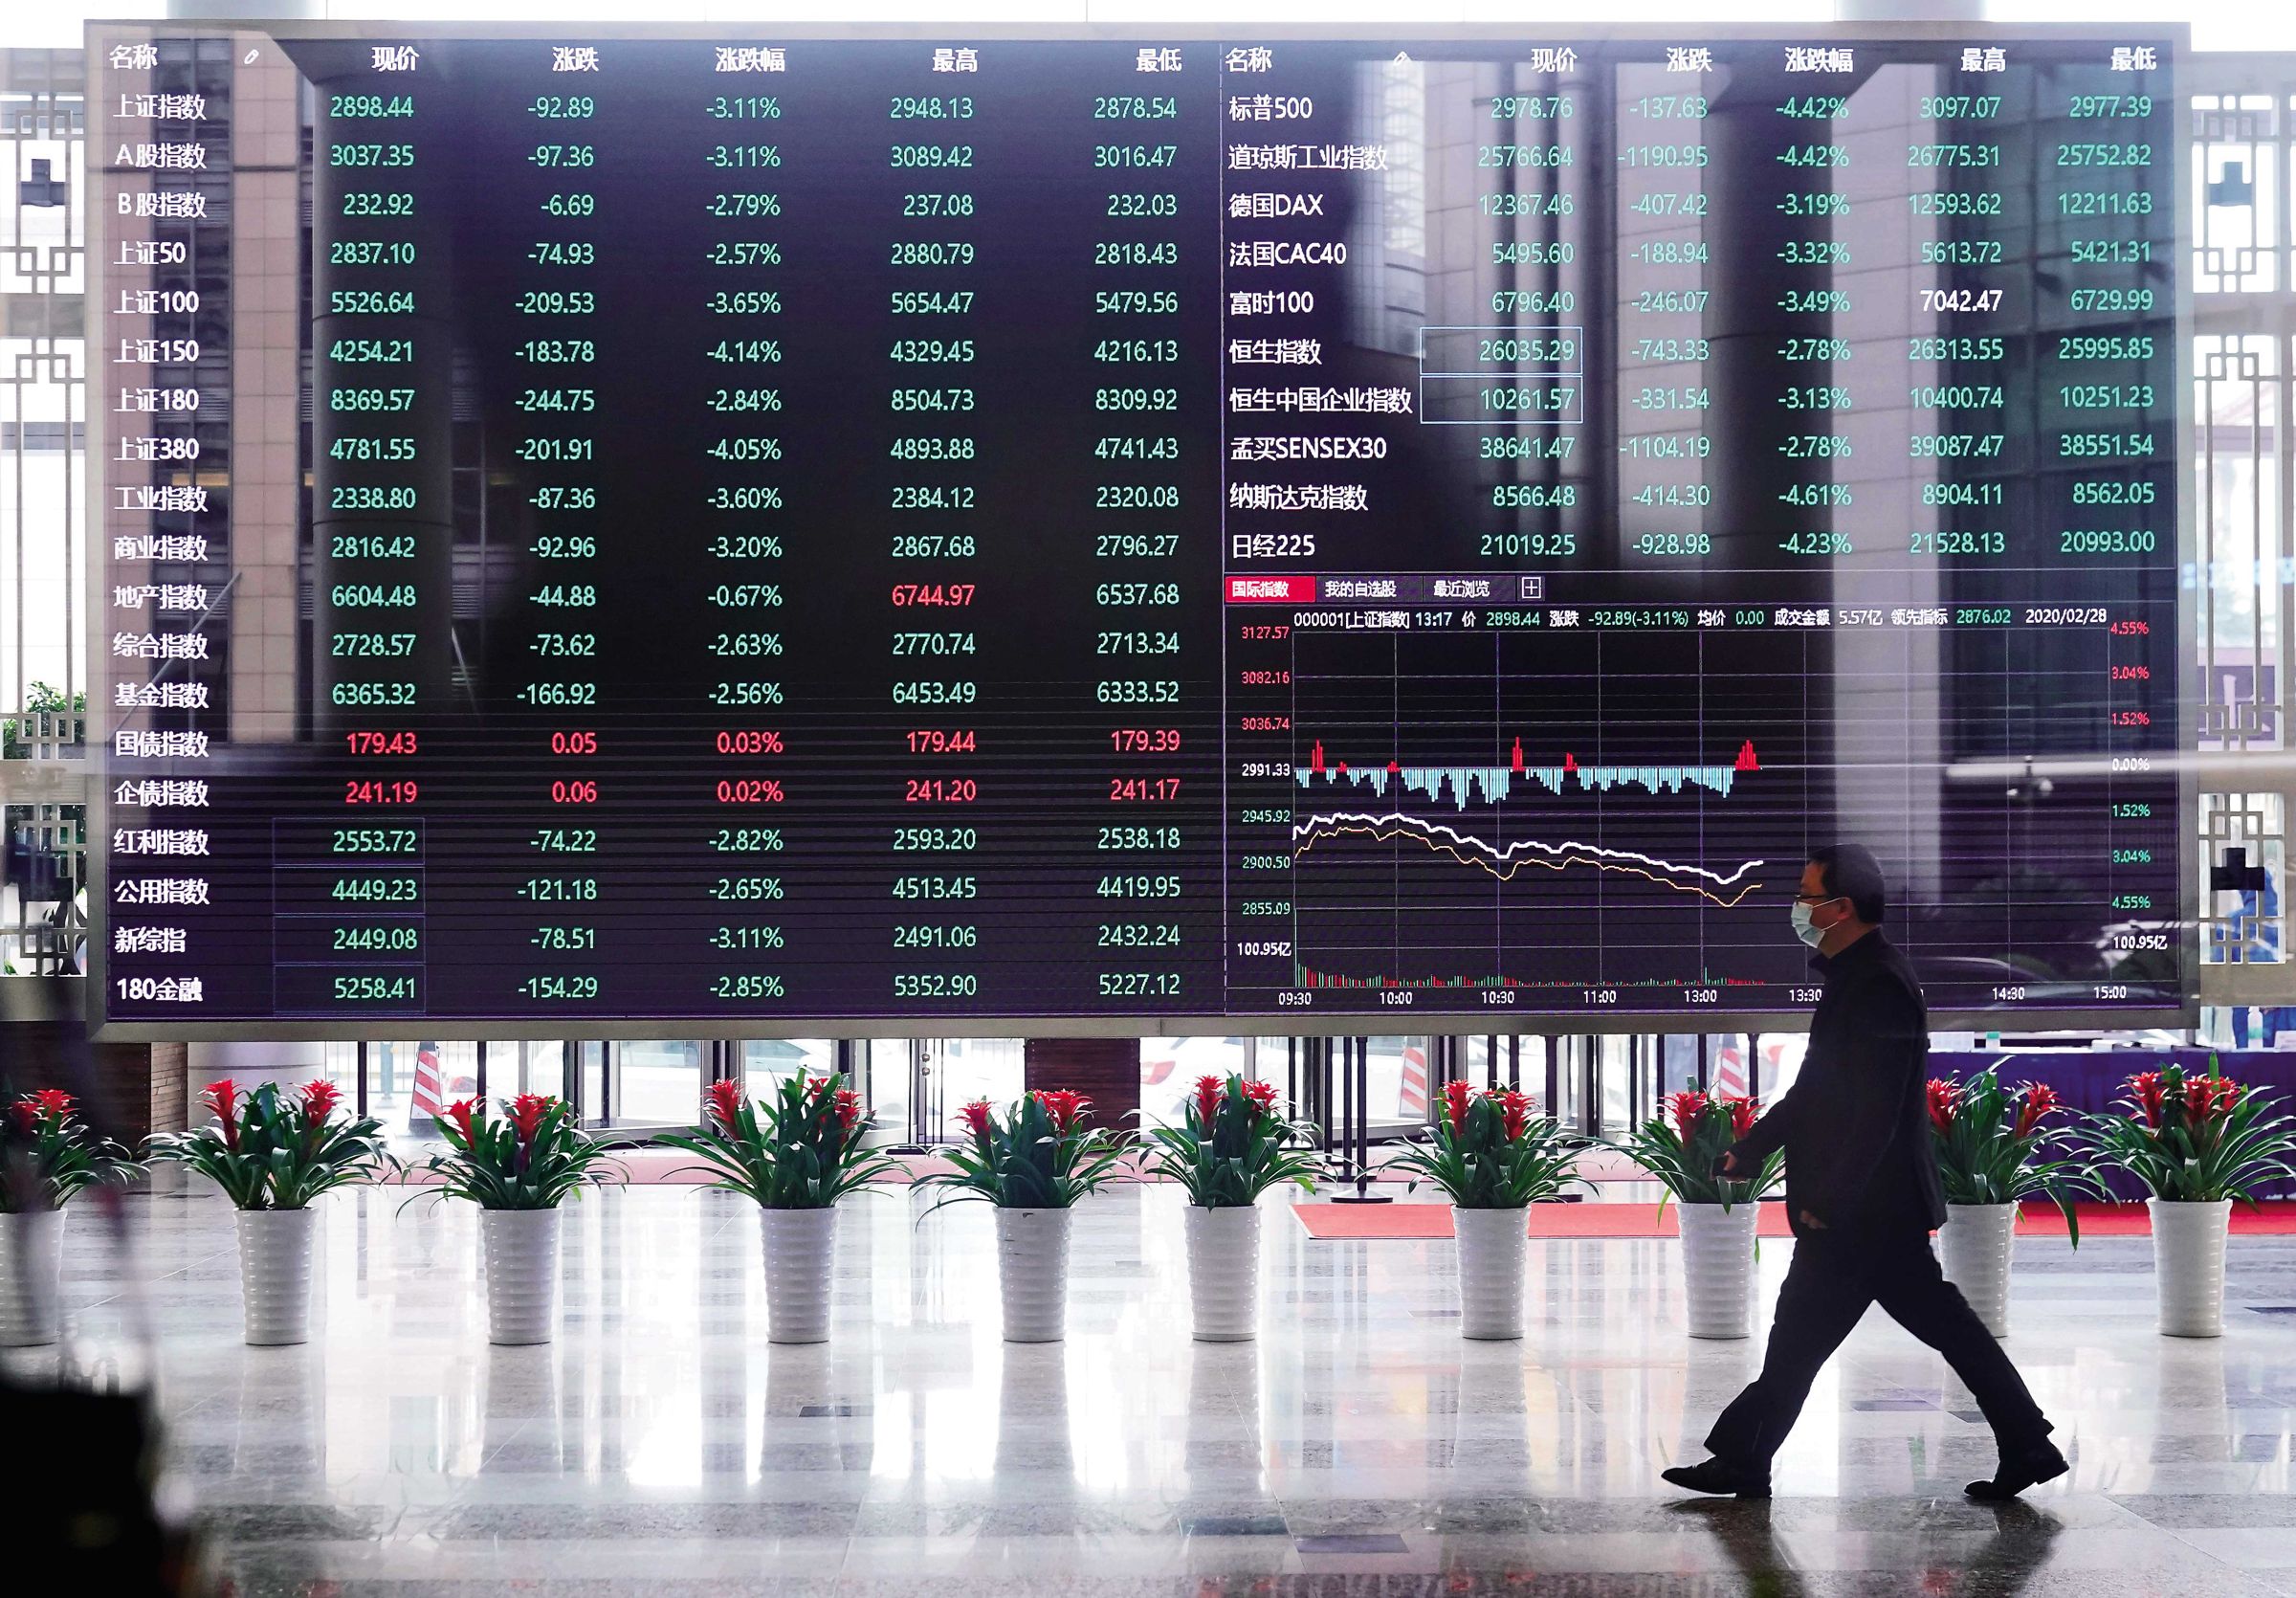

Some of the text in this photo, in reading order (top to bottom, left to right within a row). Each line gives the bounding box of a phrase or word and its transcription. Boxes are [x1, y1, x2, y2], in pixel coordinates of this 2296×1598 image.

[108, 44, 1181, 72] 名称 现价 涨跌 涨跌幅 最高 最低
[1225, 47, 2156, 73] 名称 现价 涨跌 涨跌幅 最高 最低
[113, 94, 974, 121] 上证指数 2898.44 2948.13
[1228, 96, 2152, 121] 标普500 -4.42% 3097.07 2977.39
[527, 145, 595, 167] -97.36
[1094, 145, 1178, 167] 3016.47
[1228, 144, 2152, 169] 道琼斯工业指数 -4.42% 26775.31 25752.82
[707, 194, 782, 216] -2.79%
[1228, 192, 2152, 218] 德国DAX -3.19% 12593.62 12211.63
[113, 241, 974, 267] 上证50 2837.10 2880.79
[1229, 241, 2152, 267] 法国CAC40 -3.32% 5613.72 5421.31
[113, 290, 1178, 316] 上证100 -209.53 5479.56
[1229, 289, 2153, 316] 富时100 -3.49% 7042.47 6729.99
[113, 339, 783, 365] 上证150 -4.14%
[1229, 338, 2153, 365] 恒生指数 -2.78% 26313.55 25995.85
[113, 388, 975, 413] 上证180 8369.57 8504.73
[1229, 387, 2154, 413] 恒生中国企业指数 10261.57 -331.54 -3.13% 10400.74 10251.23
[113, 437, 1179, 463] 上证380 -201.91 4741.43
[1230, 434, 2154, 461] 孟买SENSEX30 38641.47 -1104.19 -2.78% 39087.47 38551.54
[113, 486, 783, 512] 工业指数 -3.60%
[1230, 482, 2154, 510] 纳斯达克指数 8566.48 -414.30 -4.61% 8904.11 8562.05
[113, 535, 976, 561] 商业指数 2816.42 2867.68
[1232, 531, 2154, 559] 日经225 21019.25 -928.98 -4.23% 21528.13 20993.00
[114, 584, 1180, 610] 地产指数 -44.88 6537.68
[1233, 580, 1490, 598] 国际指数 我的自选股 最近浏览
[1416, 612, 1451, 626] 13:17
[1462, 611, 1475, 627] 价
[1487, 612, 1540, 626] 2898.44
[1550, 610, 1578, 627] 涨跌
[1698, 610, 1725, 626] 均价
[1736, 611, 1764, 625] 0.00
[1775, 610, 1830, 626] 成交金额
[1839, 610, 1883, 625] 5.57亿
[1891, 609, 1948, 625] 领先指标
[1957, 610, 2011, 623] 2876.02
[2026, 609, 2107, 624] 2020/02/28
[2110, 622, 2149, 634] 4.55%
[114, 633, 784, 658] 综合指数 -2.63%
[1242, 627, 1289, 639] 3127.57
[1242, 672, 1289, 684] 3082.16
[2112, 667, 2149, 679] 3.04%
[114, 681, 976, 708] 基金指数 6365.32 6453.49
[1242, 719, 1289, 730] 3036.74
[2112, 713, 2149, 725] 1.52%
[114, 730, 1180, 757] 国债指数 0.05 179.39
[1243, 765, 1290, 776] 2991.33
[2112, 758, 2150, 771] 0.00%
[114, 780, 784, 806] 企债指数 0.02%
[1243, 810, 1290, 822] 2945.92
[2112, 805, 2150, 817] 1.52%
[114, 829, 977, 854] 红利指数 2553.72 2593.20
[1243, 856, 1290, 868] 2900.50
[2113, 851, 2150, 862] 3.04%
[114, 877, 1181, 903] 公用指数 -121.18 4419.95
[2112, 897, 2150, 908] 4.55%
[1243, 902, 1290, 915] 2855.09
[114, 926, 784, 952] 新综指 -3.11%
[1238, 943, 1291, 956] 100.95亿
[2113, 936, 2167, 949] 100.95亿
[114, 974, 978, 1001] 180金融 5258.41 5352.90
[1279, 987, 2127, 1006] 09:30 10:00 10:30 11:00 13:00 13:30 14:30 15:00
